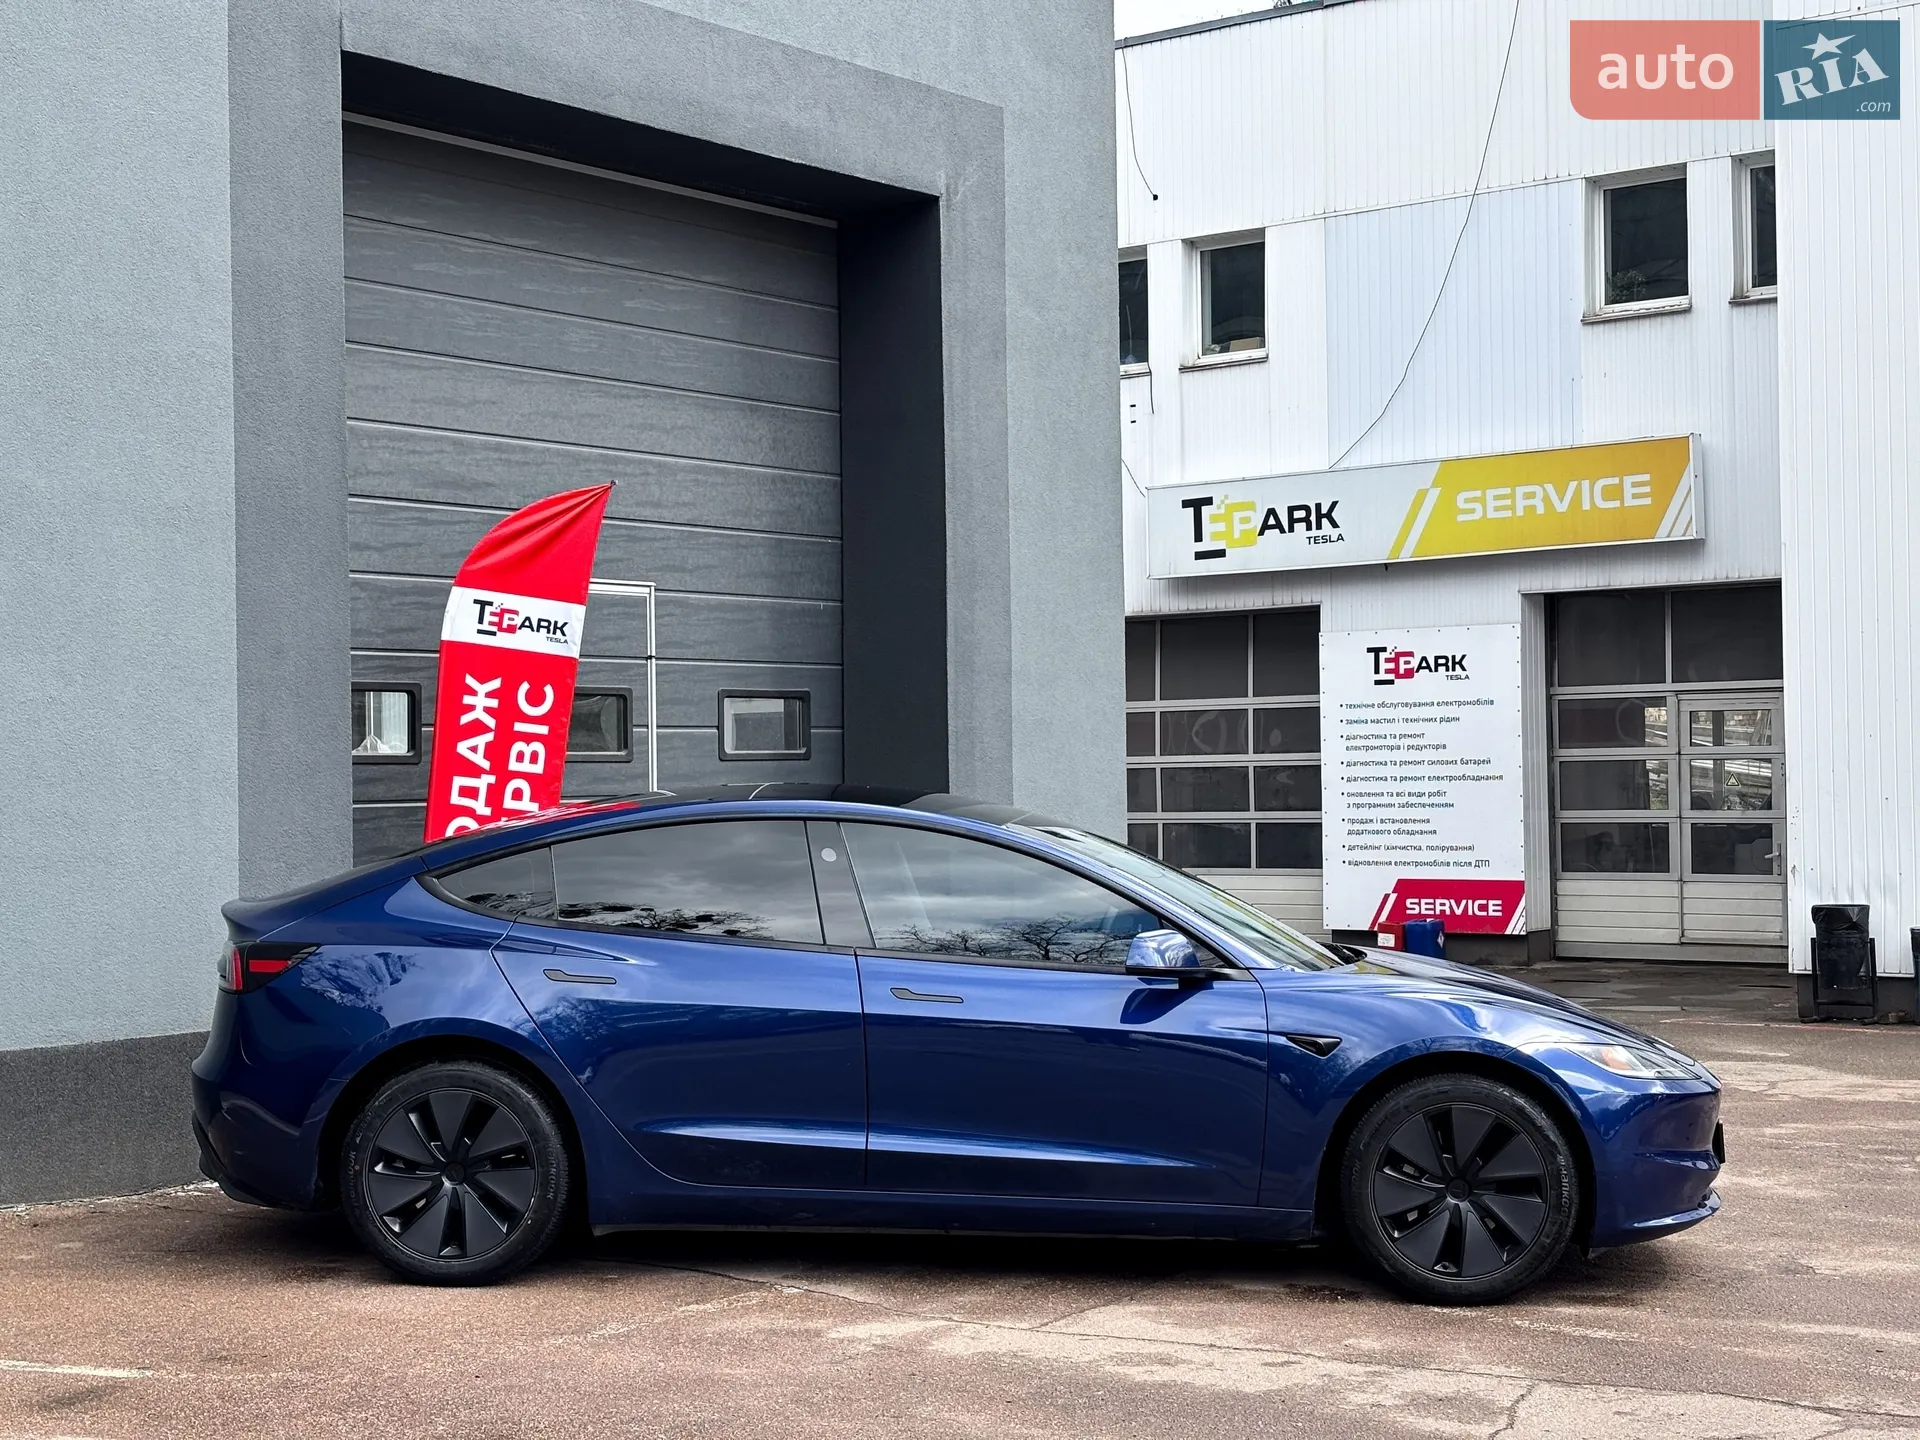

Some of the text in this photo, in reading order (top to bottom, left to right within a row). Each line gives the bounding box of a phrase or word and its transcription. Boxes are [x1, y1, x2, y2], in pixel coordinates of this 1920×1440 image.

[1456, 473, 1652, 522] SERVICE
[1305, 532, 1345, 546] TESLA
[545, 635, 569, 645] TESLA
[1377, 700, 1434, 709] обслуговування
[1437, 698, 1495, 708] електромобілів
[1345, 717, 1368, 725] заміна
[1402, 716, 1438, 724] технічних
[1440, 715, 1460, 724] рідин
[1345, 733, 1387, 741] діагностика
[1345, 742, 1447, 752] електромоторів і редукторів
[1346, 759, 1388, 767] діагностика
[1460, 757, 1491, 766] батарей
[1346, 774, 1388, 783] діагностика
[1399, 775, 1426, 783] ремонт
[1427, 774, 1503, 782] електрообладнання
[1428, 790, 1447, 799] робіт
[1347, 817, 1374, 825] продаж
[1393, 828, 1437, 836] обладнання
[1347, 843, 1475, 852] детейлінг (хімчистка, полірування)
[1348, 859, 1392, 867] відновлення
[1394, 859, 1451, 867] електромобілів
[1474, 860, 1490, 868] ДТП
[1405, 899, 1502, 916] SERVICE
